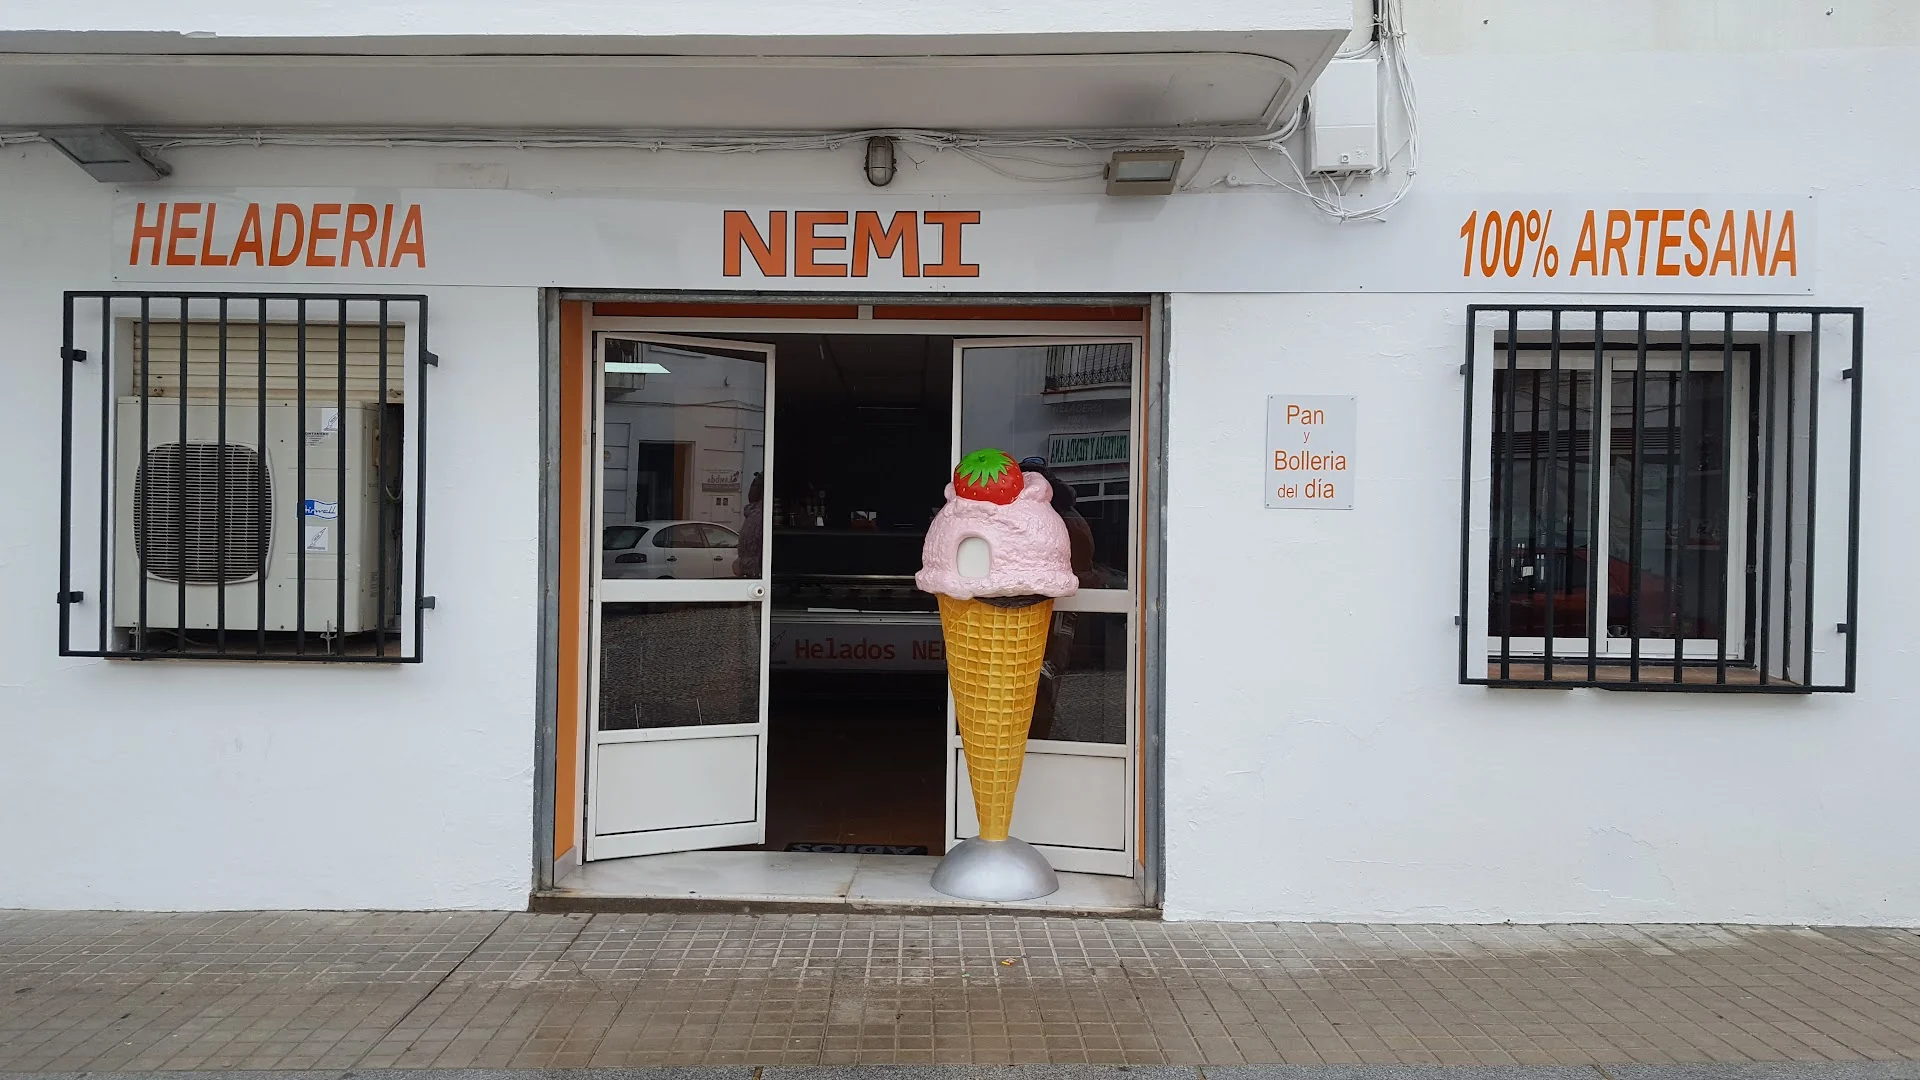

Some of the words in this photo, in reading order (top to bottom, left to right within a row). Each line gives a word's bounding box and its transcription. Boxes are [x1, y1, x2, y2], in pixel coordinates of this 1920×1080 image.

[129, 202, 426, 269] HELADERIA
[723, 210, 981, 278] NEMI
[1460, 208, 1559, 278] 100%
[1569, 208, 1798, 279] ARTESANA
[1286, 404, 1325, 425] Pan
[1303, 431, 1311, 444] y
[1275, 450, 1347, 471] Bolleria
[1277, 483, 1298, 498] del
[1305, 478, 1335, 499] día
[795, 638, 896, 660] Helados
